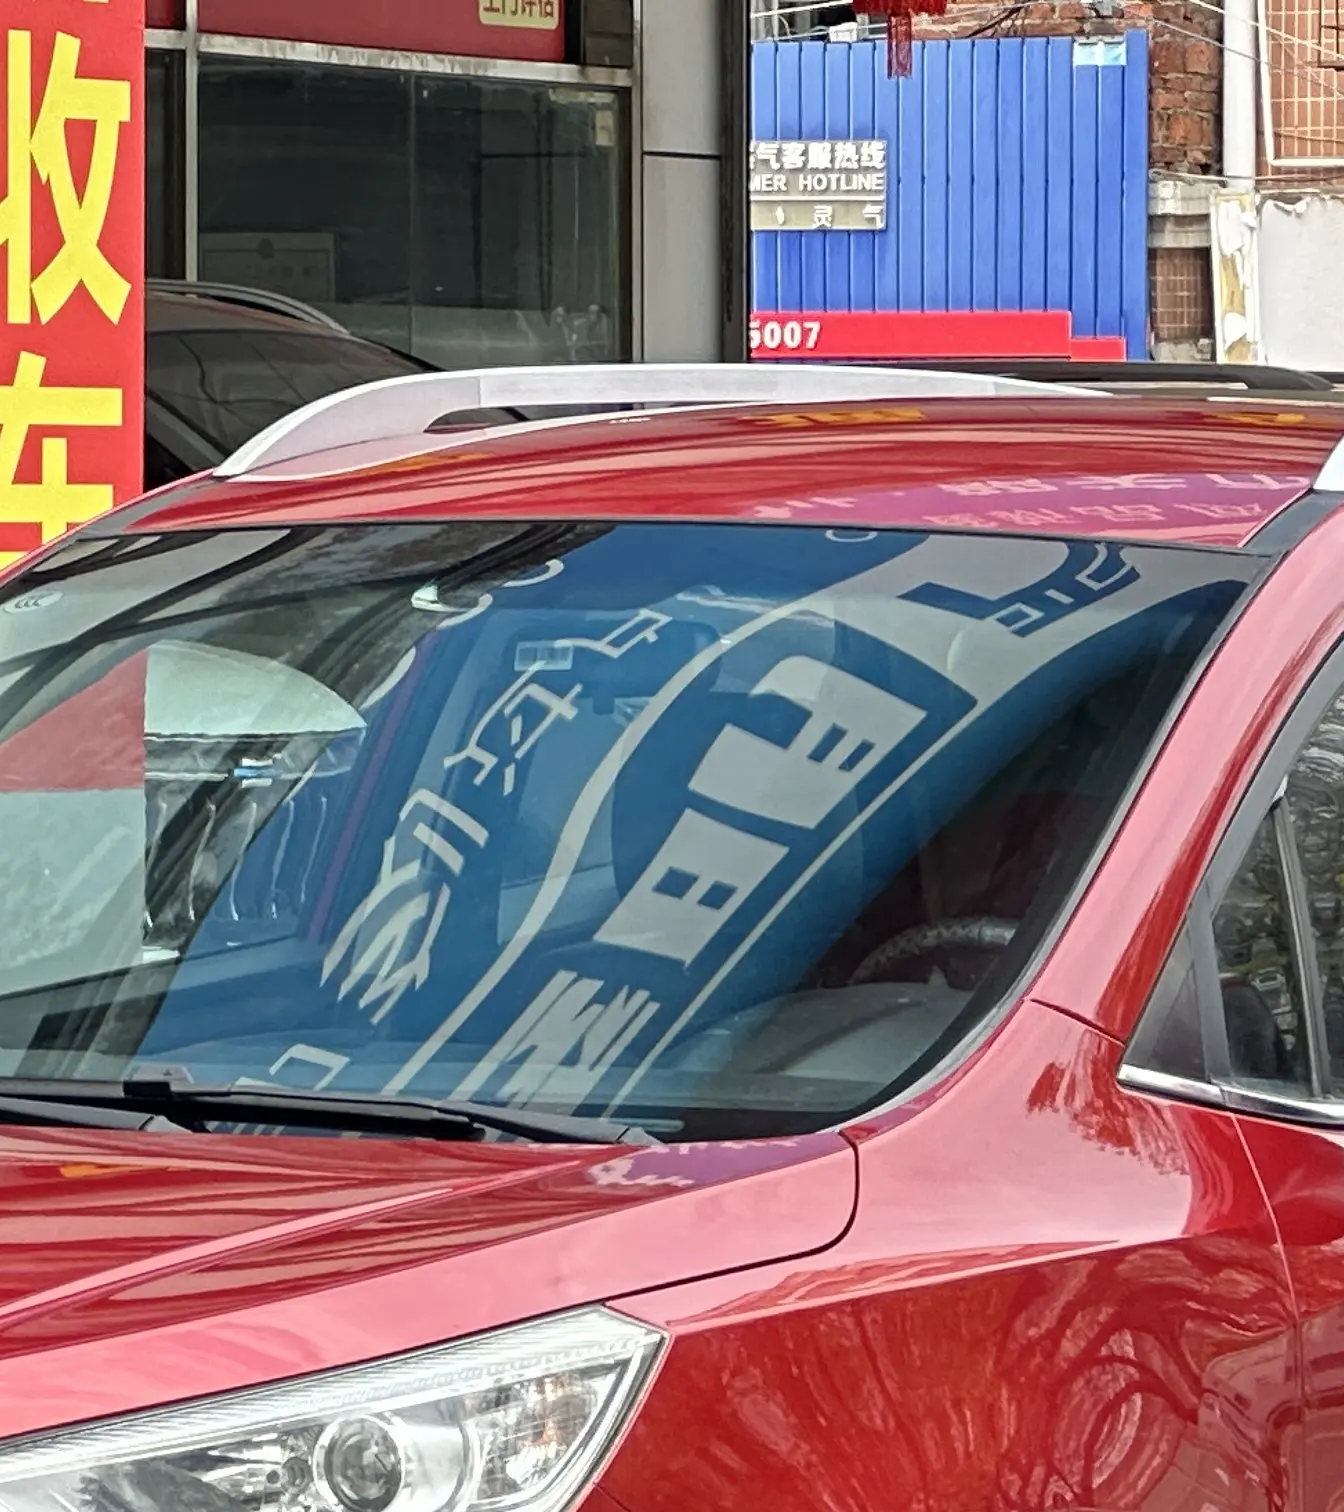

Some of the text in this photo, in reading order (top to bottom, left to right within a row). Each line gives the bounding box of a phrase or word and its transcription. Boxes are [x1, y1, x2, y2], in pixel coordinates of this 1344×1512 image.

[750, 142, 886, 170] 气客服热线
[798, 173, 884, 191] HOTLINE
[749, 320, 821, 349] 5007
